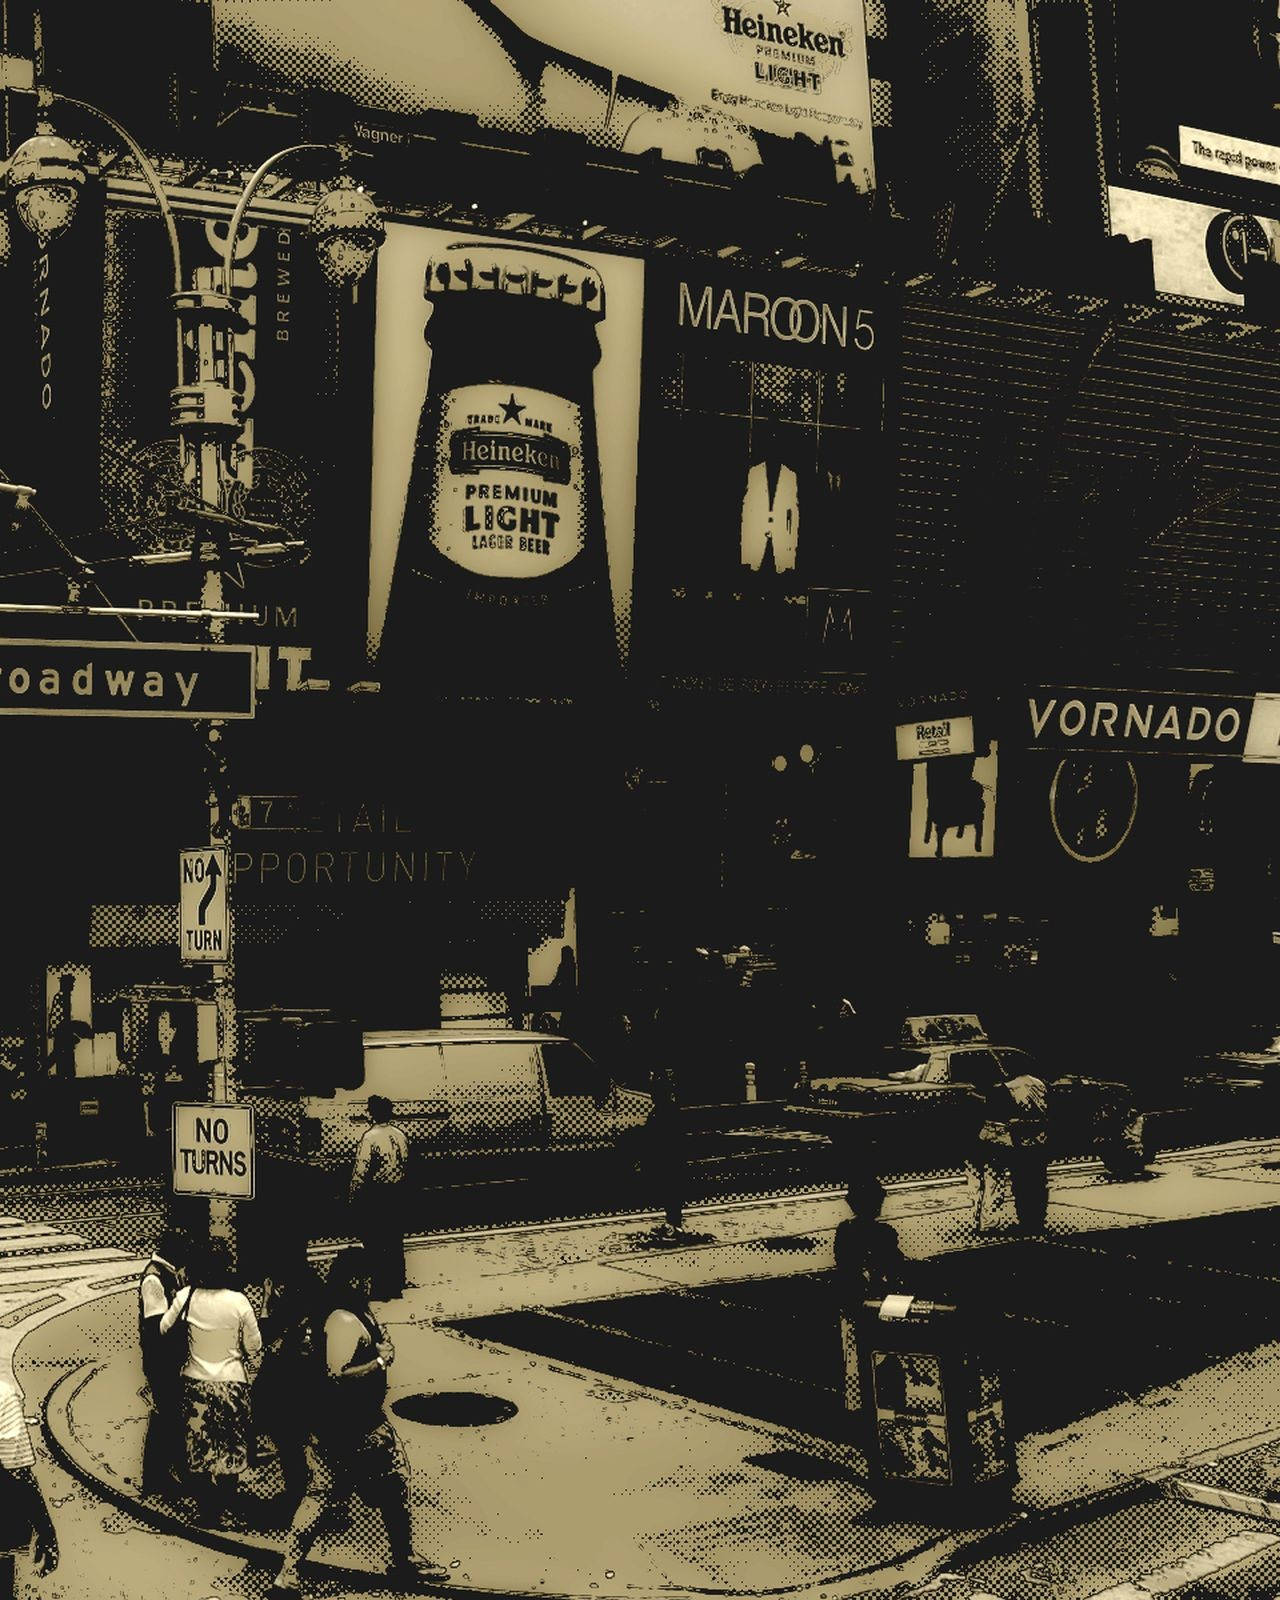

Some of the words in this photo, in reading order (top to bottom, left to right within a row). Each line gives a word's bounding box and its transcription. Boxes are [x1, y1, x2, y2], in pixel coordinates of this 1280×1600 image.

[722, 5, 846, 58] Heineken
[754, 61, 821, 91] LIGHT
[1192, 140, 1212, 158] The
[467, 414, 500, 424] TRADE
[525, 418, 552, 433] MARK
[462, 440, 561, 470] Heineken
[465, 484, 558, 508] PREMIUM
[465, 505, 560, 538] LIGHT
[472, 534, 513, 549] LAGER
[519, 536, 550, 555] BEER
[138, 599, 297, 628] PREIUM
[1028, 699, 1241, 742] VORNADO
[183, 859, 204, 884] NO
[233, 851, 477, 884] PPORTUNITY
[186, 929, 222, 951] TURN
[195, 1117, 229, 1144] NO
[180, 1148, 247, 1177] TURNS
